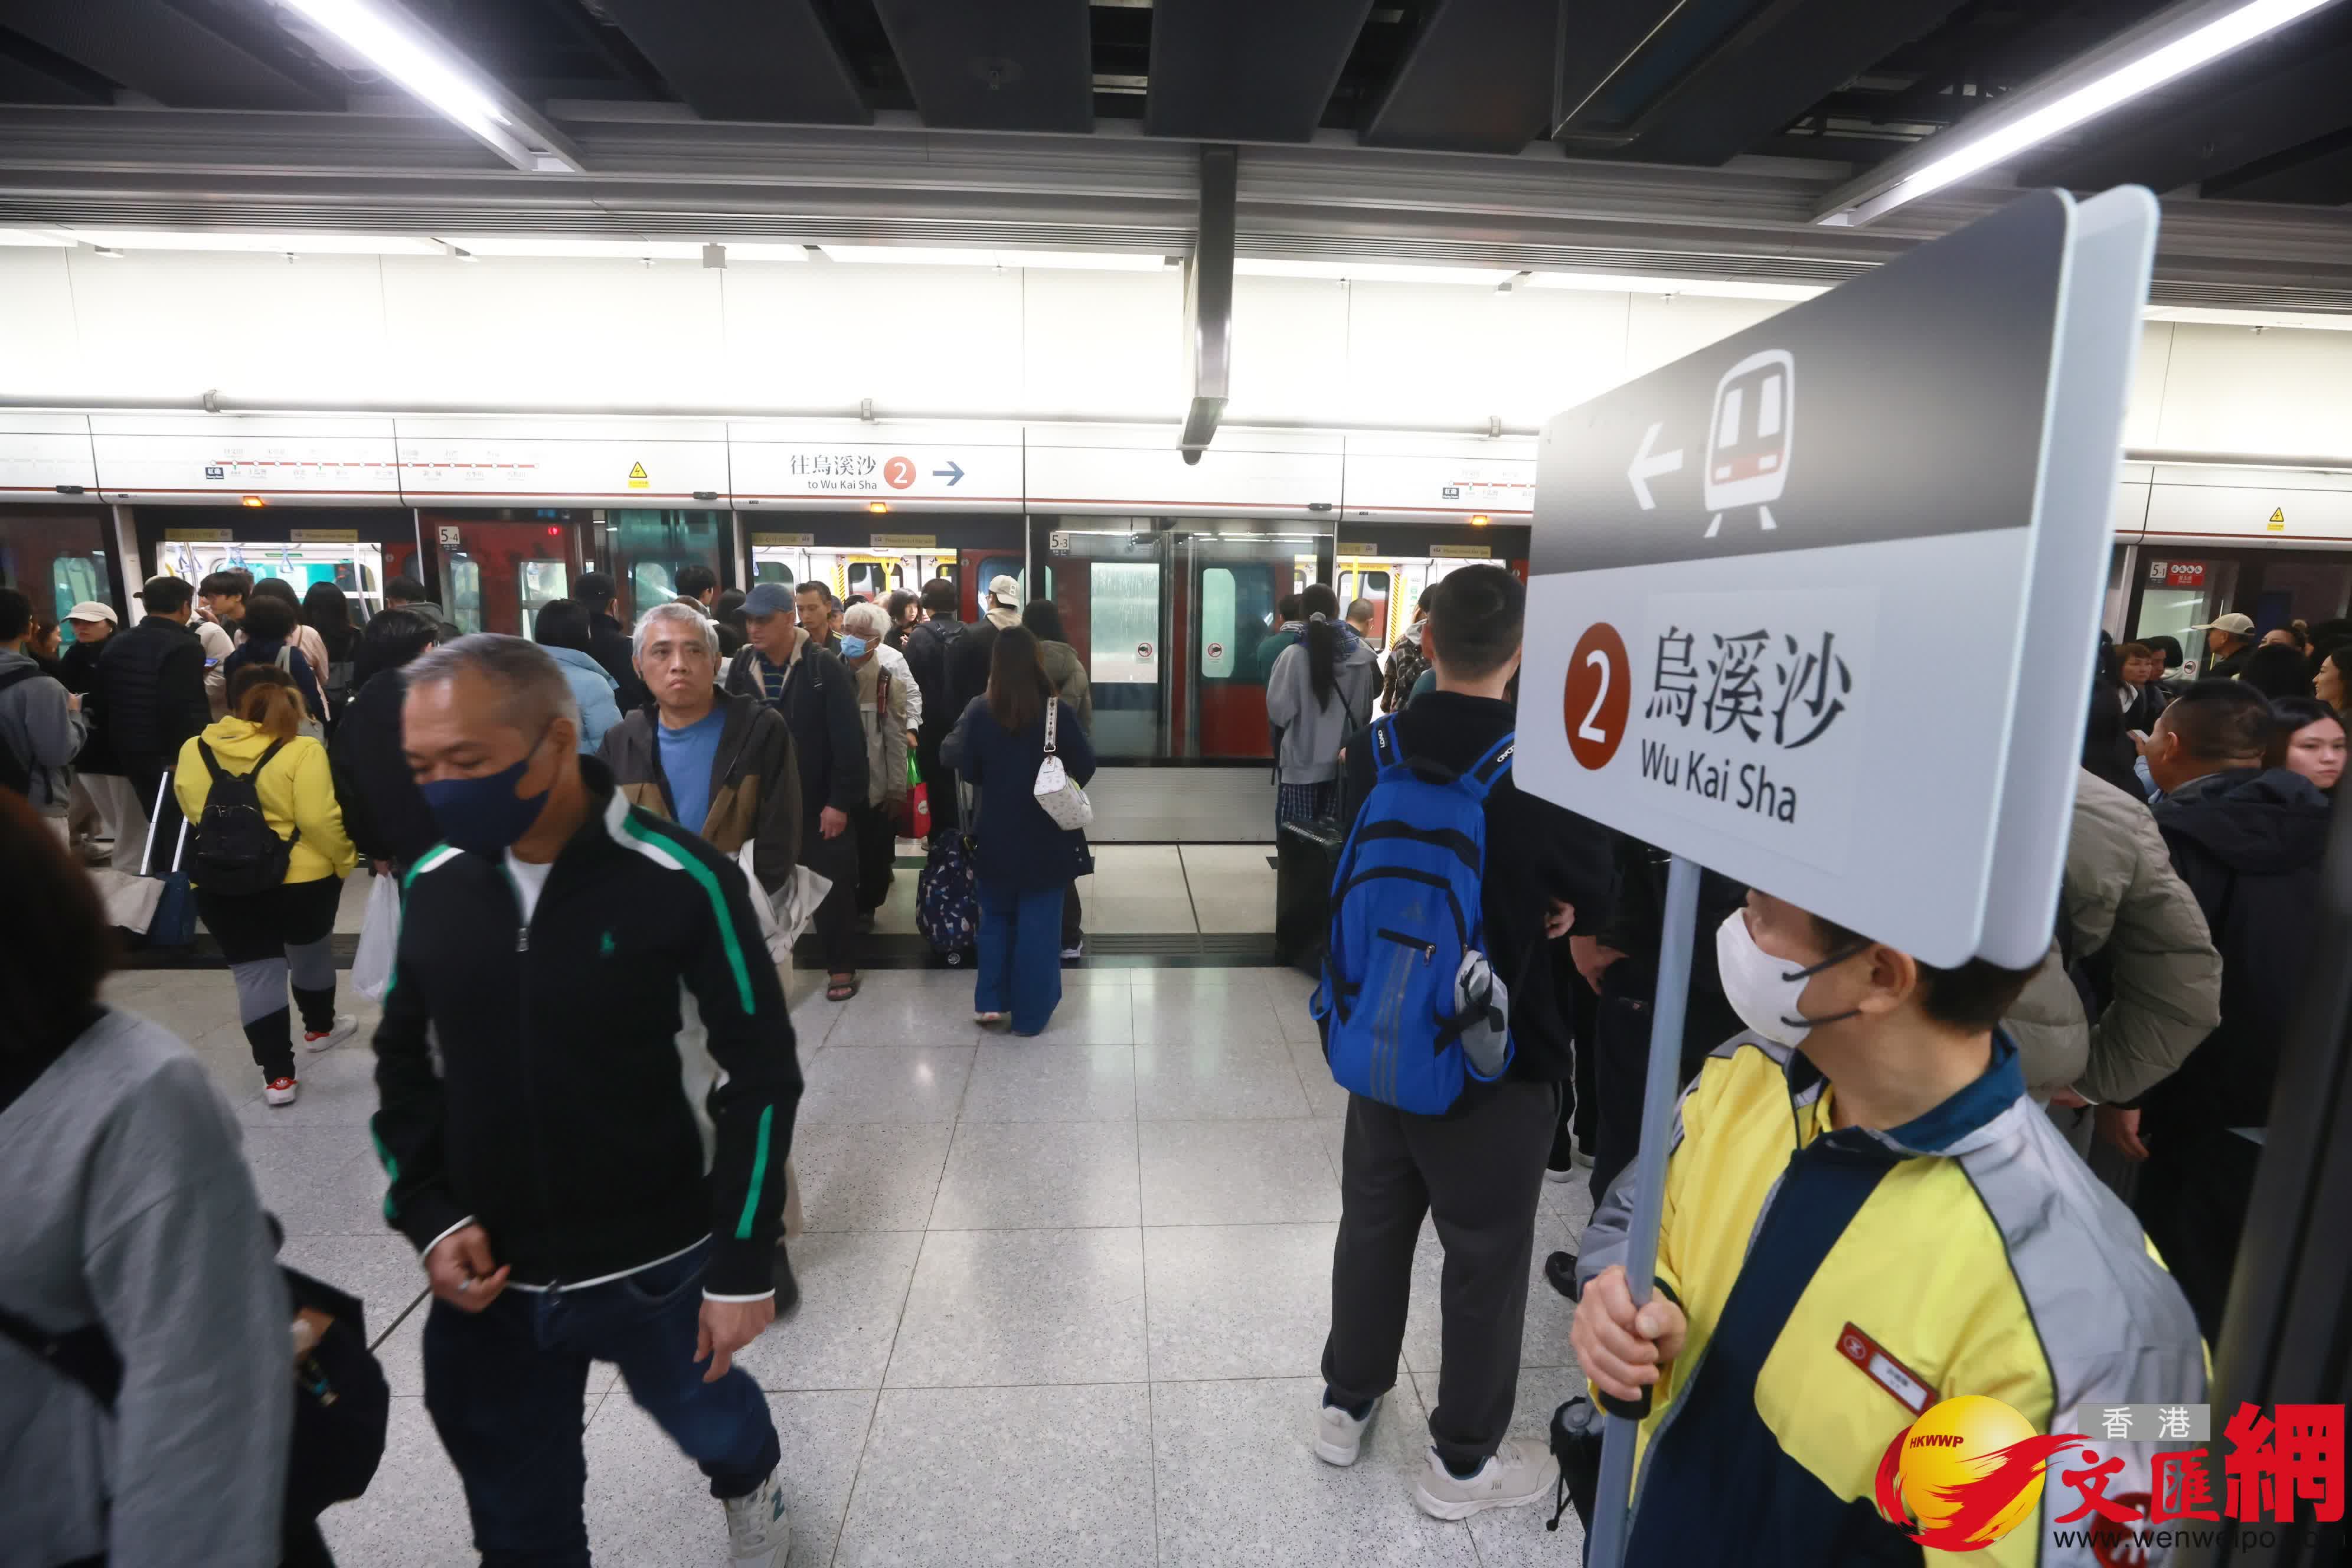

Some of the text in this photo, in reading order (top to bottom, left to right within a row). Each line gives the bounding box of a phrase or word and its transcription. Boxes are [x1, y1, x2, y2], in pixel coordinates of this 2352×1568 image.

[789, 455, 876, 475] 往烏溪沙
[893, 462, 907, 484] 2
[808, 480, 877, 489] to Wu Kai Sha
[441, 529, 458, 542] 5-4
[1051, 535, 1068, 548] 5-3
[2151, 564, 2165, 577] 5-1
[1579, 649, 1611, 744] 2
[1645, 626, 1852, 749] 烏溪沙
[1642, 739, 1796, 824] Wu Kai Sha
